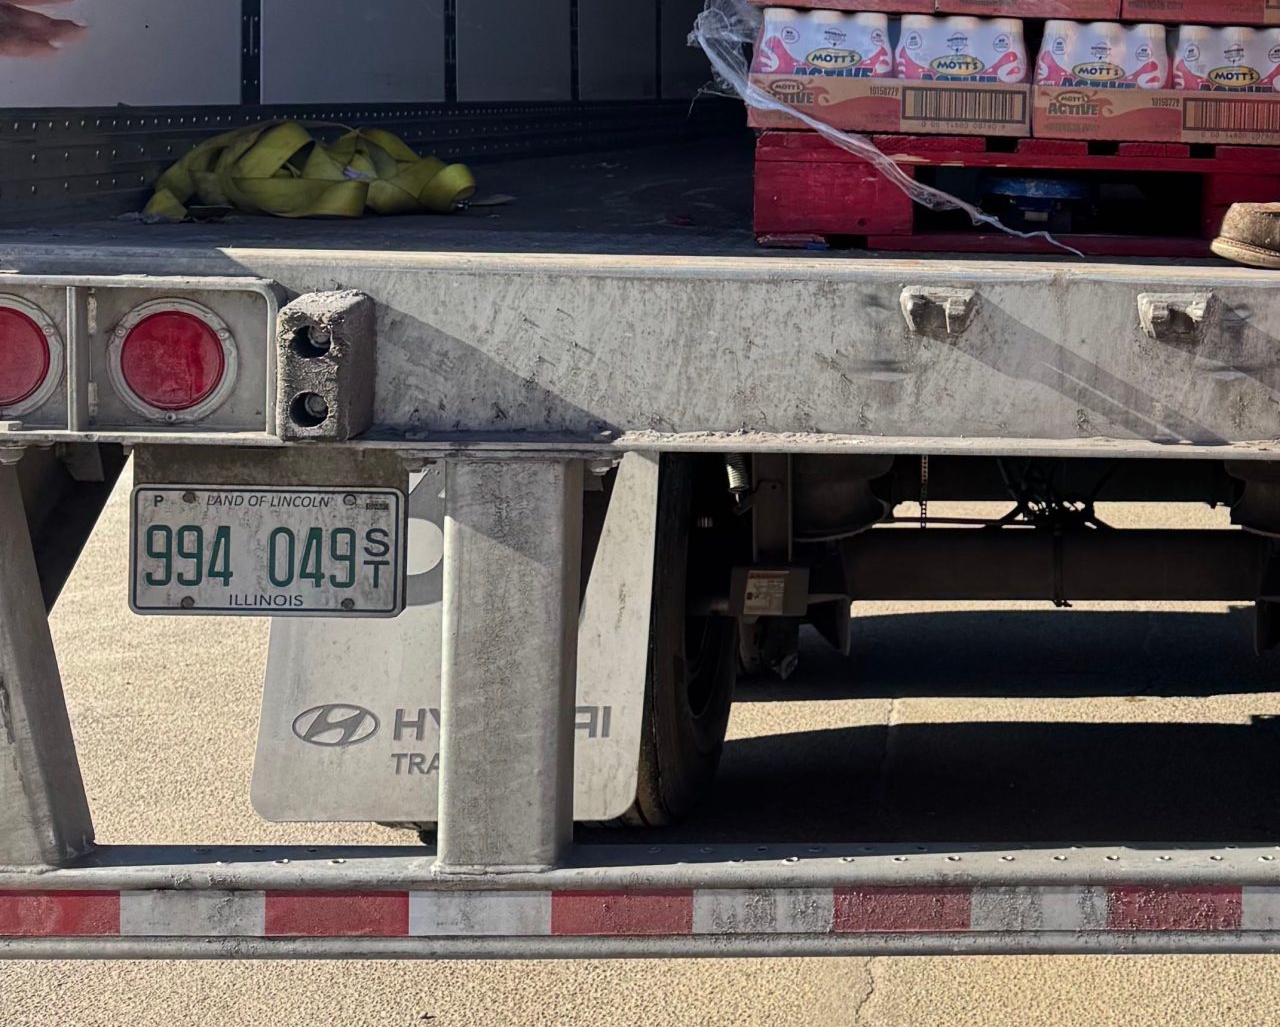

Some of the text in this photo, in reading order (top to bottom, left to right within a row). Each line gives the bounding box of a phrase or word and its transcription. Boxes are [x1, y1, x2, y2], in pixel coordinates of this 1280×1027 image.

[811, 53, 856, 64] MOTT'S
[937, 60, 978, 70] MOTT'S
[1214, 71, 1255, 81] MOTT'S
[1048, 103, 1098, 115] ACTIVE
[154, 494, 165, 507] P
[206, 494, 329, 508] LAND OF LINCOLN
[145, 524, 356, 588] 994 049
[229, 594, 304, 606] ILLINOIS
